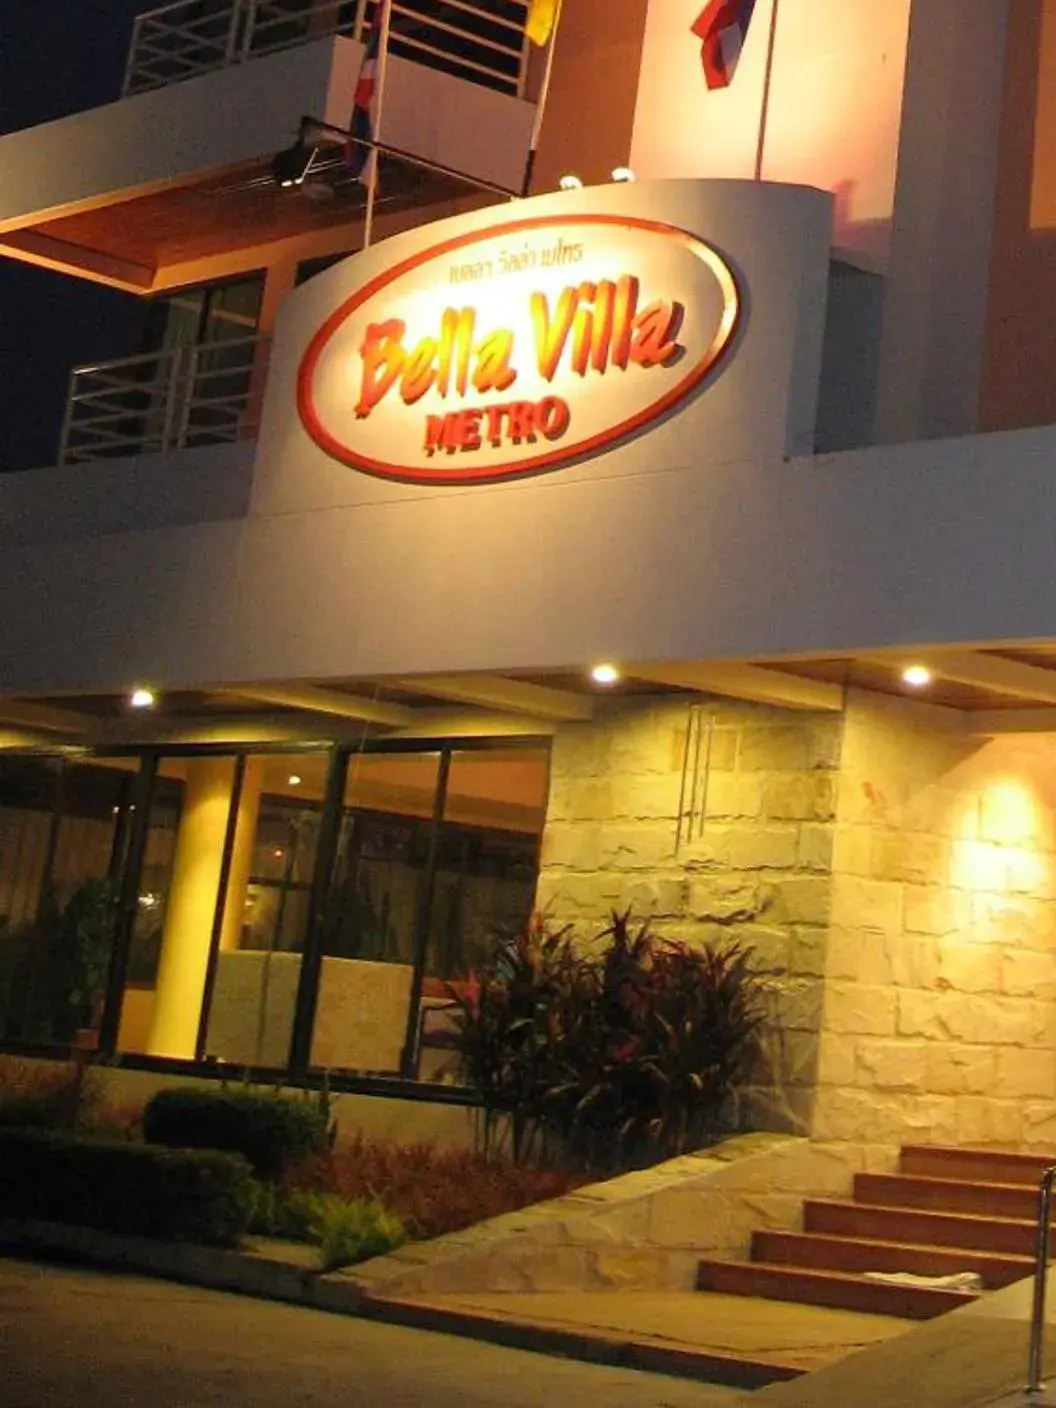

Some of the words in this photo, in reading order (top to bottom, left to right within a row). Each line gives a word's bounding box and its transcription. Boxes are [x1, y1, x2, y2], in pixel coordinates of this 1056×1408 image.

[355, 306, 517, 418] Bella
[531, 274, 685, 382] Villa
[424, 395, 570, 456] METRO
